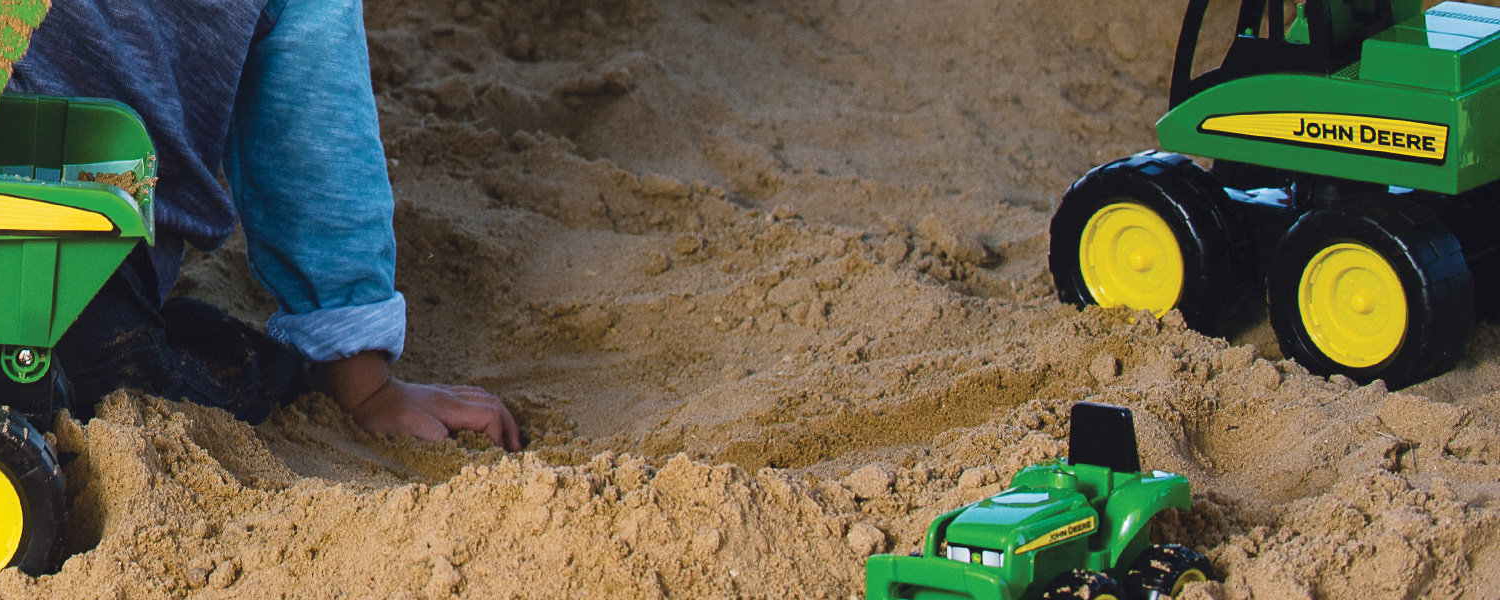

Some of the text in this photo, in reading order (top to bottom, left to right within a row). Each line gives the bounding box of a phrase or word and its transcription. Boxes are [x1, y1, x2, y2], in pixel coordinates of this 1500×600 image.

[1292, 118, 1436, 152] JOHN DEERE
[1067, 520, 1091, 535] DEERE
